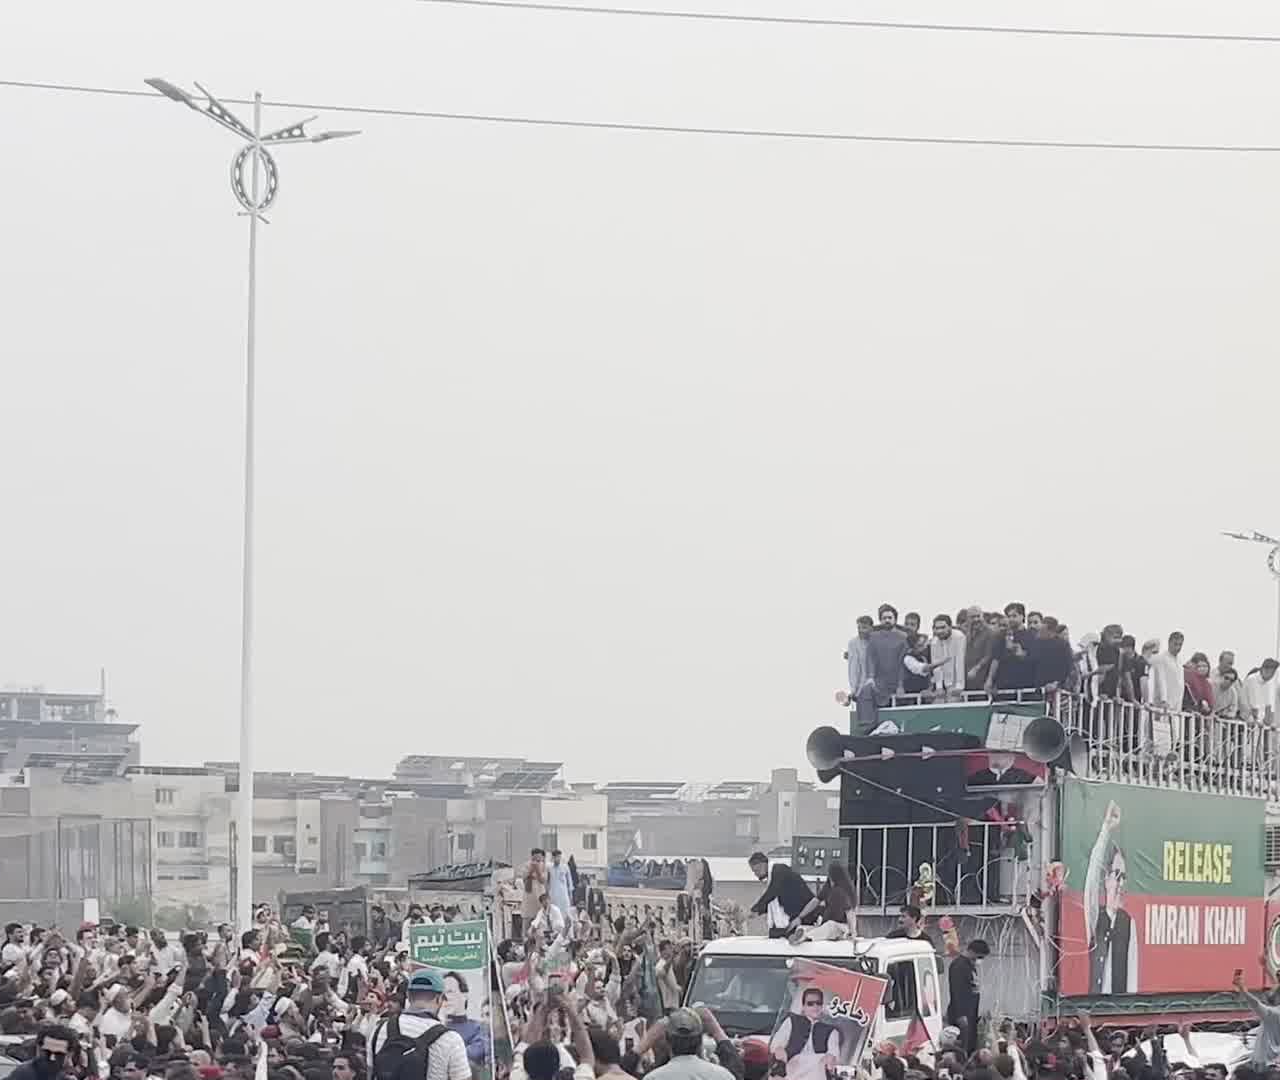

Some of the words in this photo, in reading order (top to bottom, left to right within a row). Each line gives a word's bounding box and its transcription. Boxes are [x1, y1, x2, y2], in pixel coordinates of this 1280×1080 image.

[1162, 840, 1232, 884] RELEASE
[1144, 903, 1200, 945] IMRAN
[1203, 905, 1246, 945] KHAN
